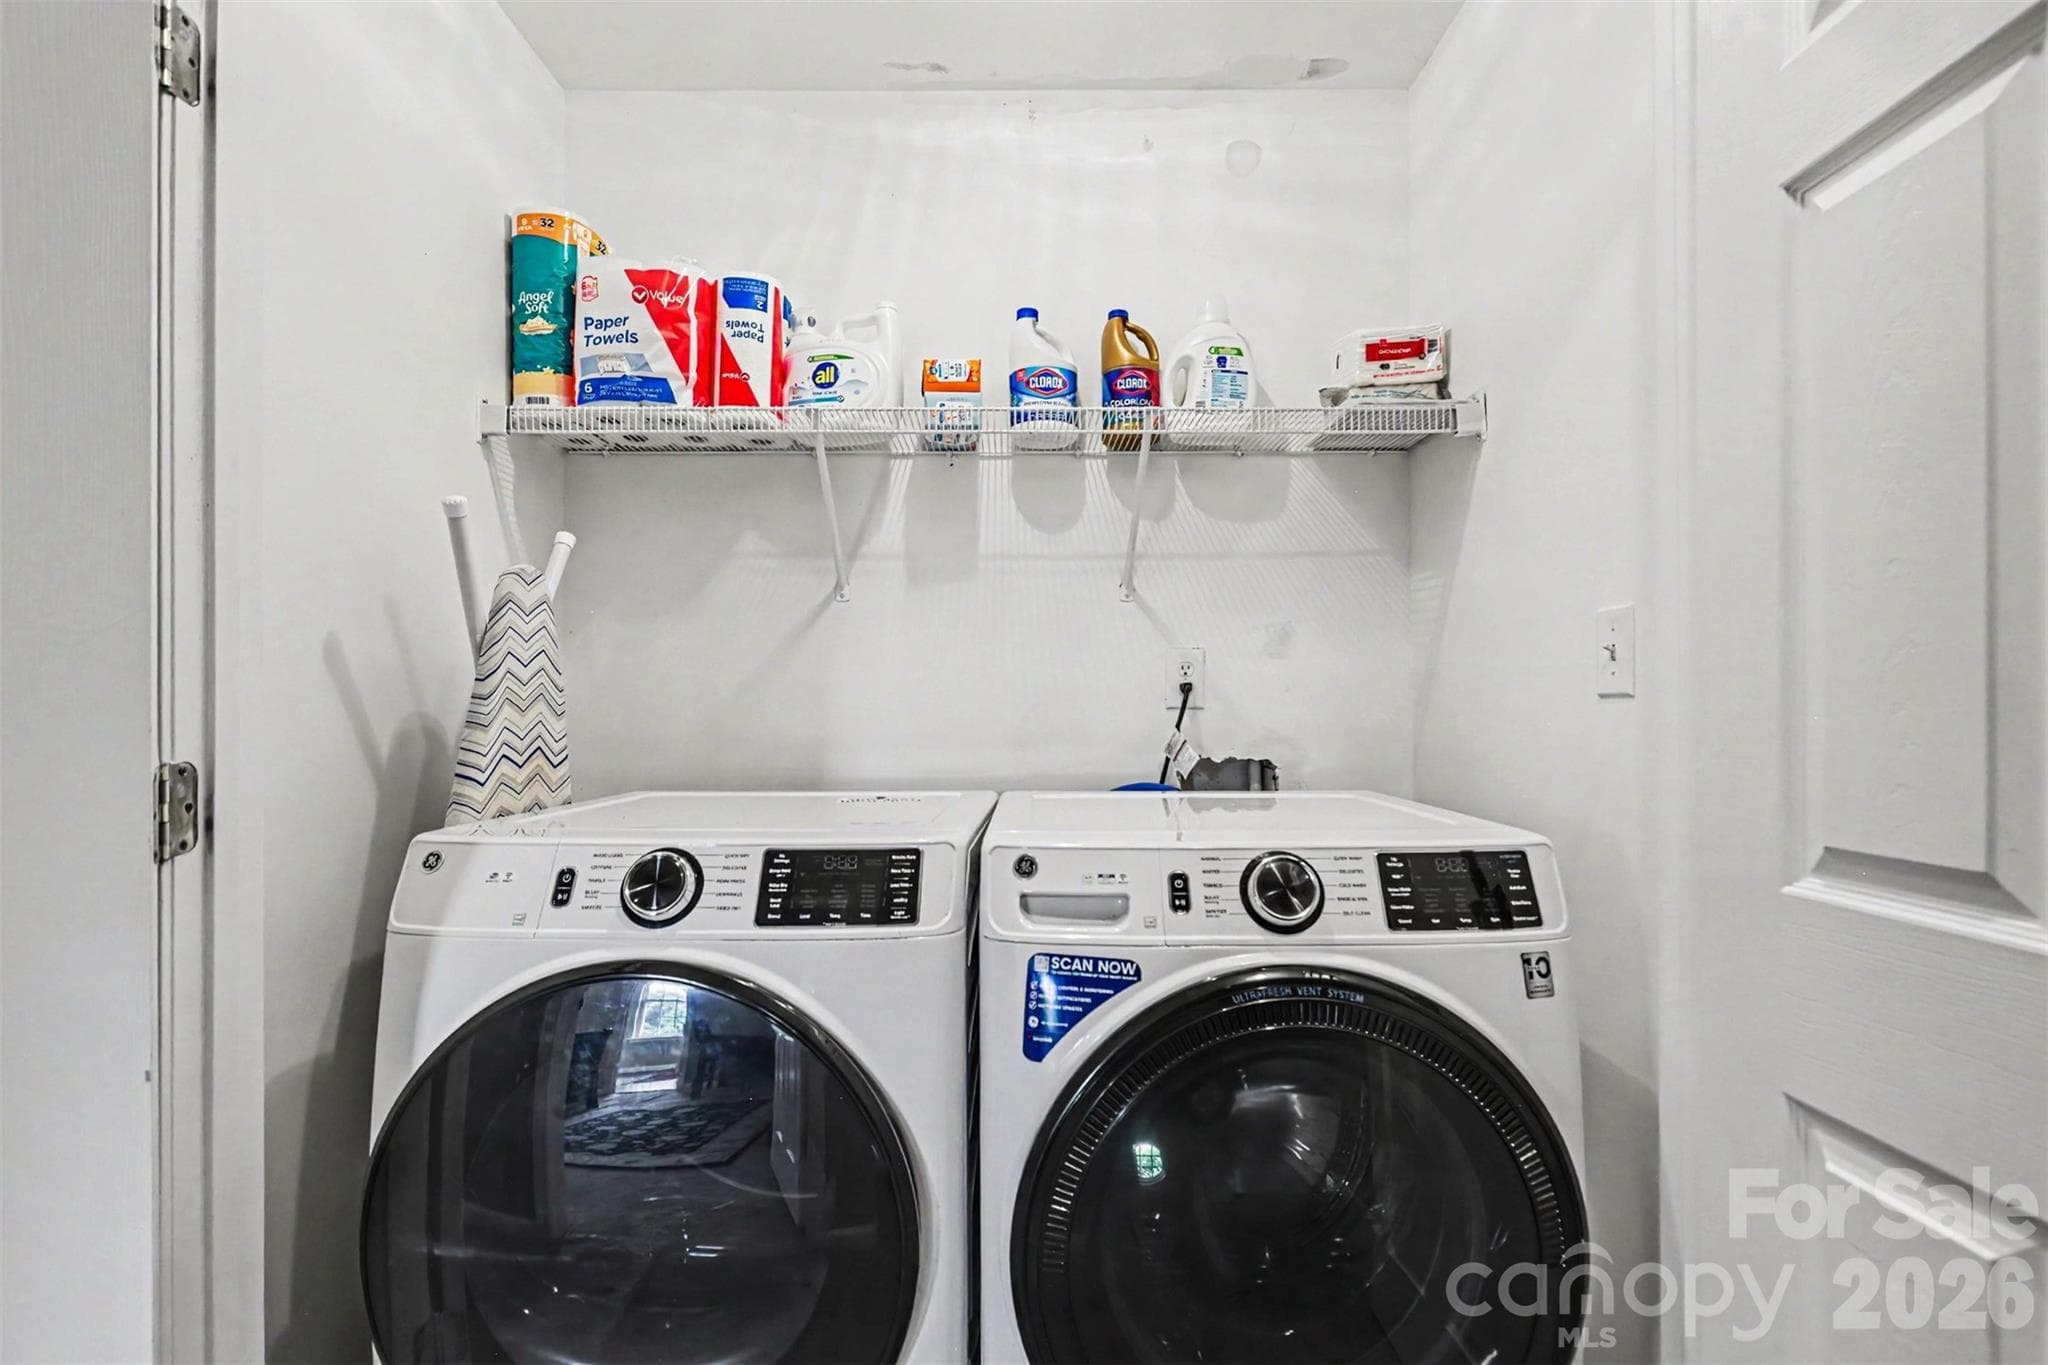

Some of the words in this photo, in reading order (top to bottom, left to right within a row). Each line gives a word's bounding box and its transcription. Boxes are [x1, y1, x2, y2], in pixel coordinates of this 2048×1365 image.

[540, 217, 555, 228] 32
[518, 290, 554, 305] Angel
[525, 301, 549, 314] Soft
[584, 316, 630, 331] Paper
[725, 320, 765, 333] Towels
[584, 330, 639, 347] Towels
[731, 330, 764, 344] Paper
[814, 366, 835, 384] all
[584, 382, 593, 393] 6
[1030, 376, 1064, 389] CLOROX
[1117, 378, 1147, 390] CLOROX
[1051, 957, 1094, 972] SCAN
[1098, 960, 1137, 976] NOW
[1296, 986, 1322, 996] VENT
[1327, 988, 1365, 1003] SYSTEM
